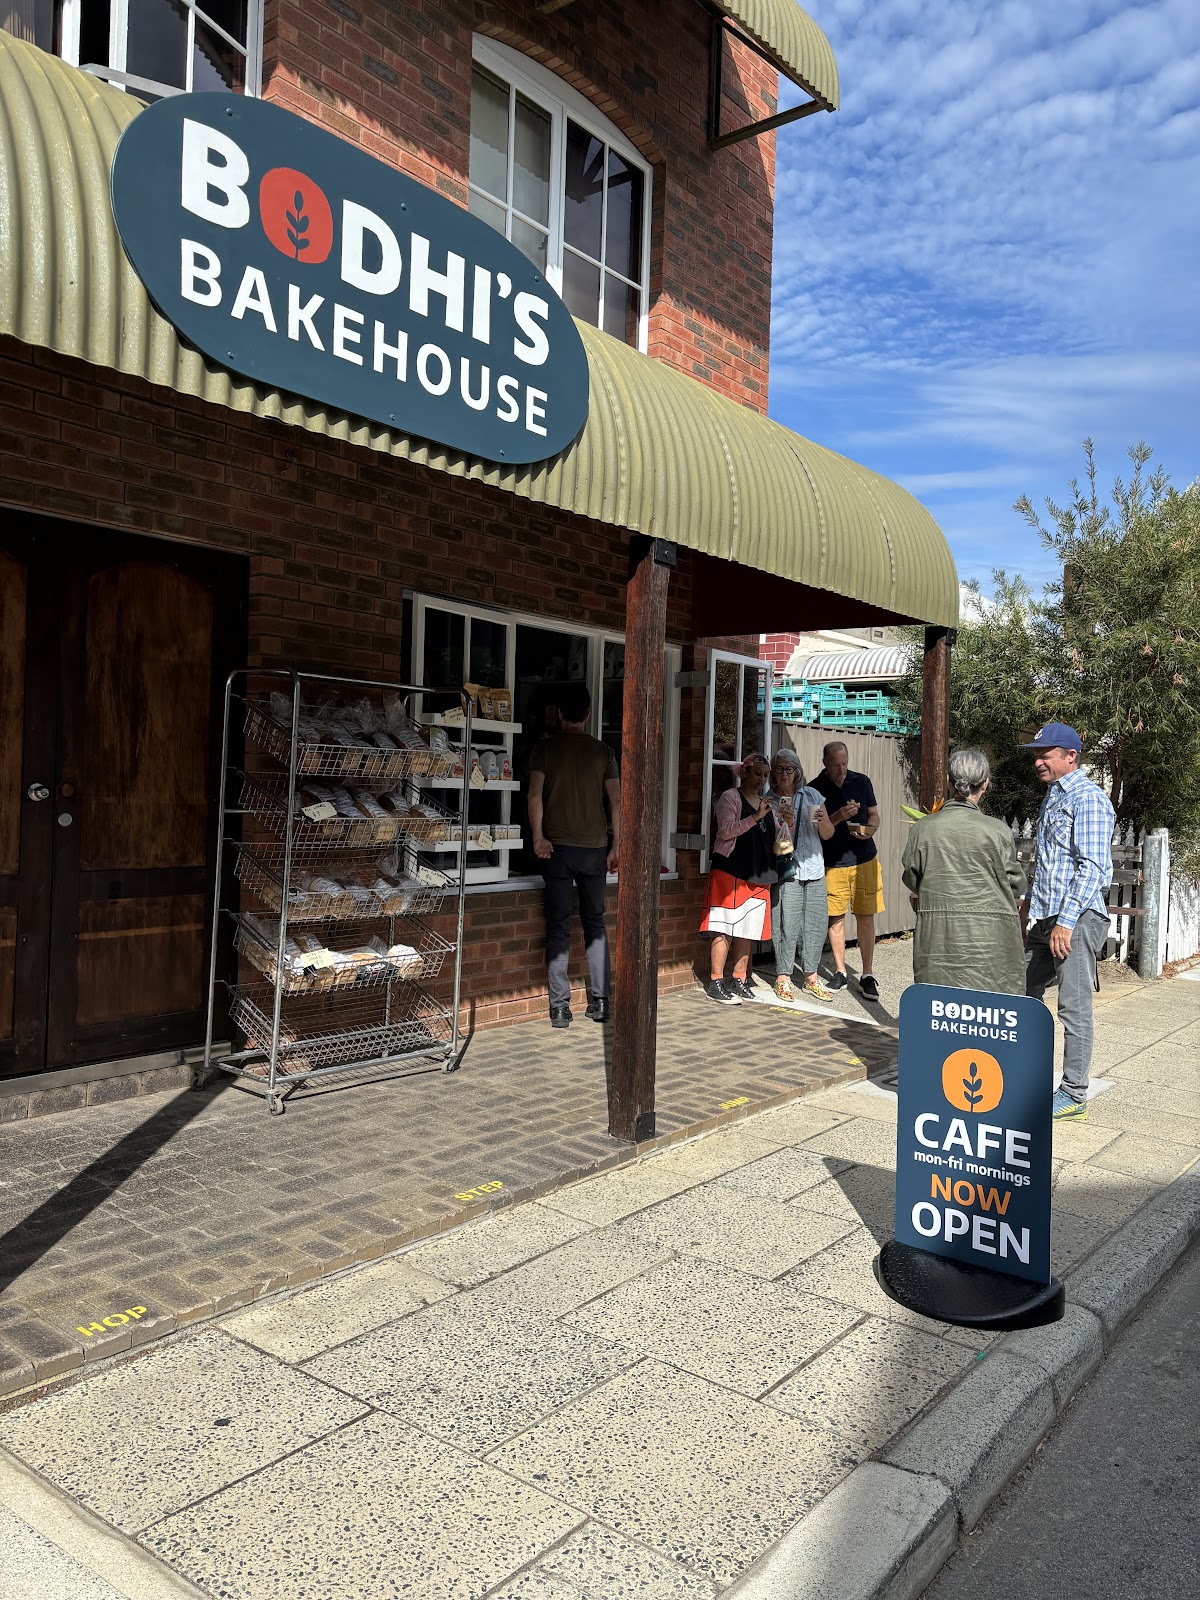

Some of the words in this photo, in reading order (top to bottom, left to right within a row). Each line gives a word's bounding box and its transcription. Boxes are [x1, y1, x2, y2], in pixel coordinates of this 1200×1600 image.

[182, 117, 550, 367] BODHI'S
[181, 238, 549, 437] BAKEHOUSE
[930, 1019, 1019, 1043] BAKEHOUSE
[931, 1000, 1019, 1028] BODHI'S
[914, 1112, 1032, 1168] CAFE
[914, 1150, 963, 1171] mon-fri
[966, 1162, 1031, 1187] mornings
[454, 1181, 503, 1200] STEP
[930, 1173, 1012, 1215] NOW
[911, 1201, 1031, 1265] OPEN
[76, 1305, 147, 1337] HOP
